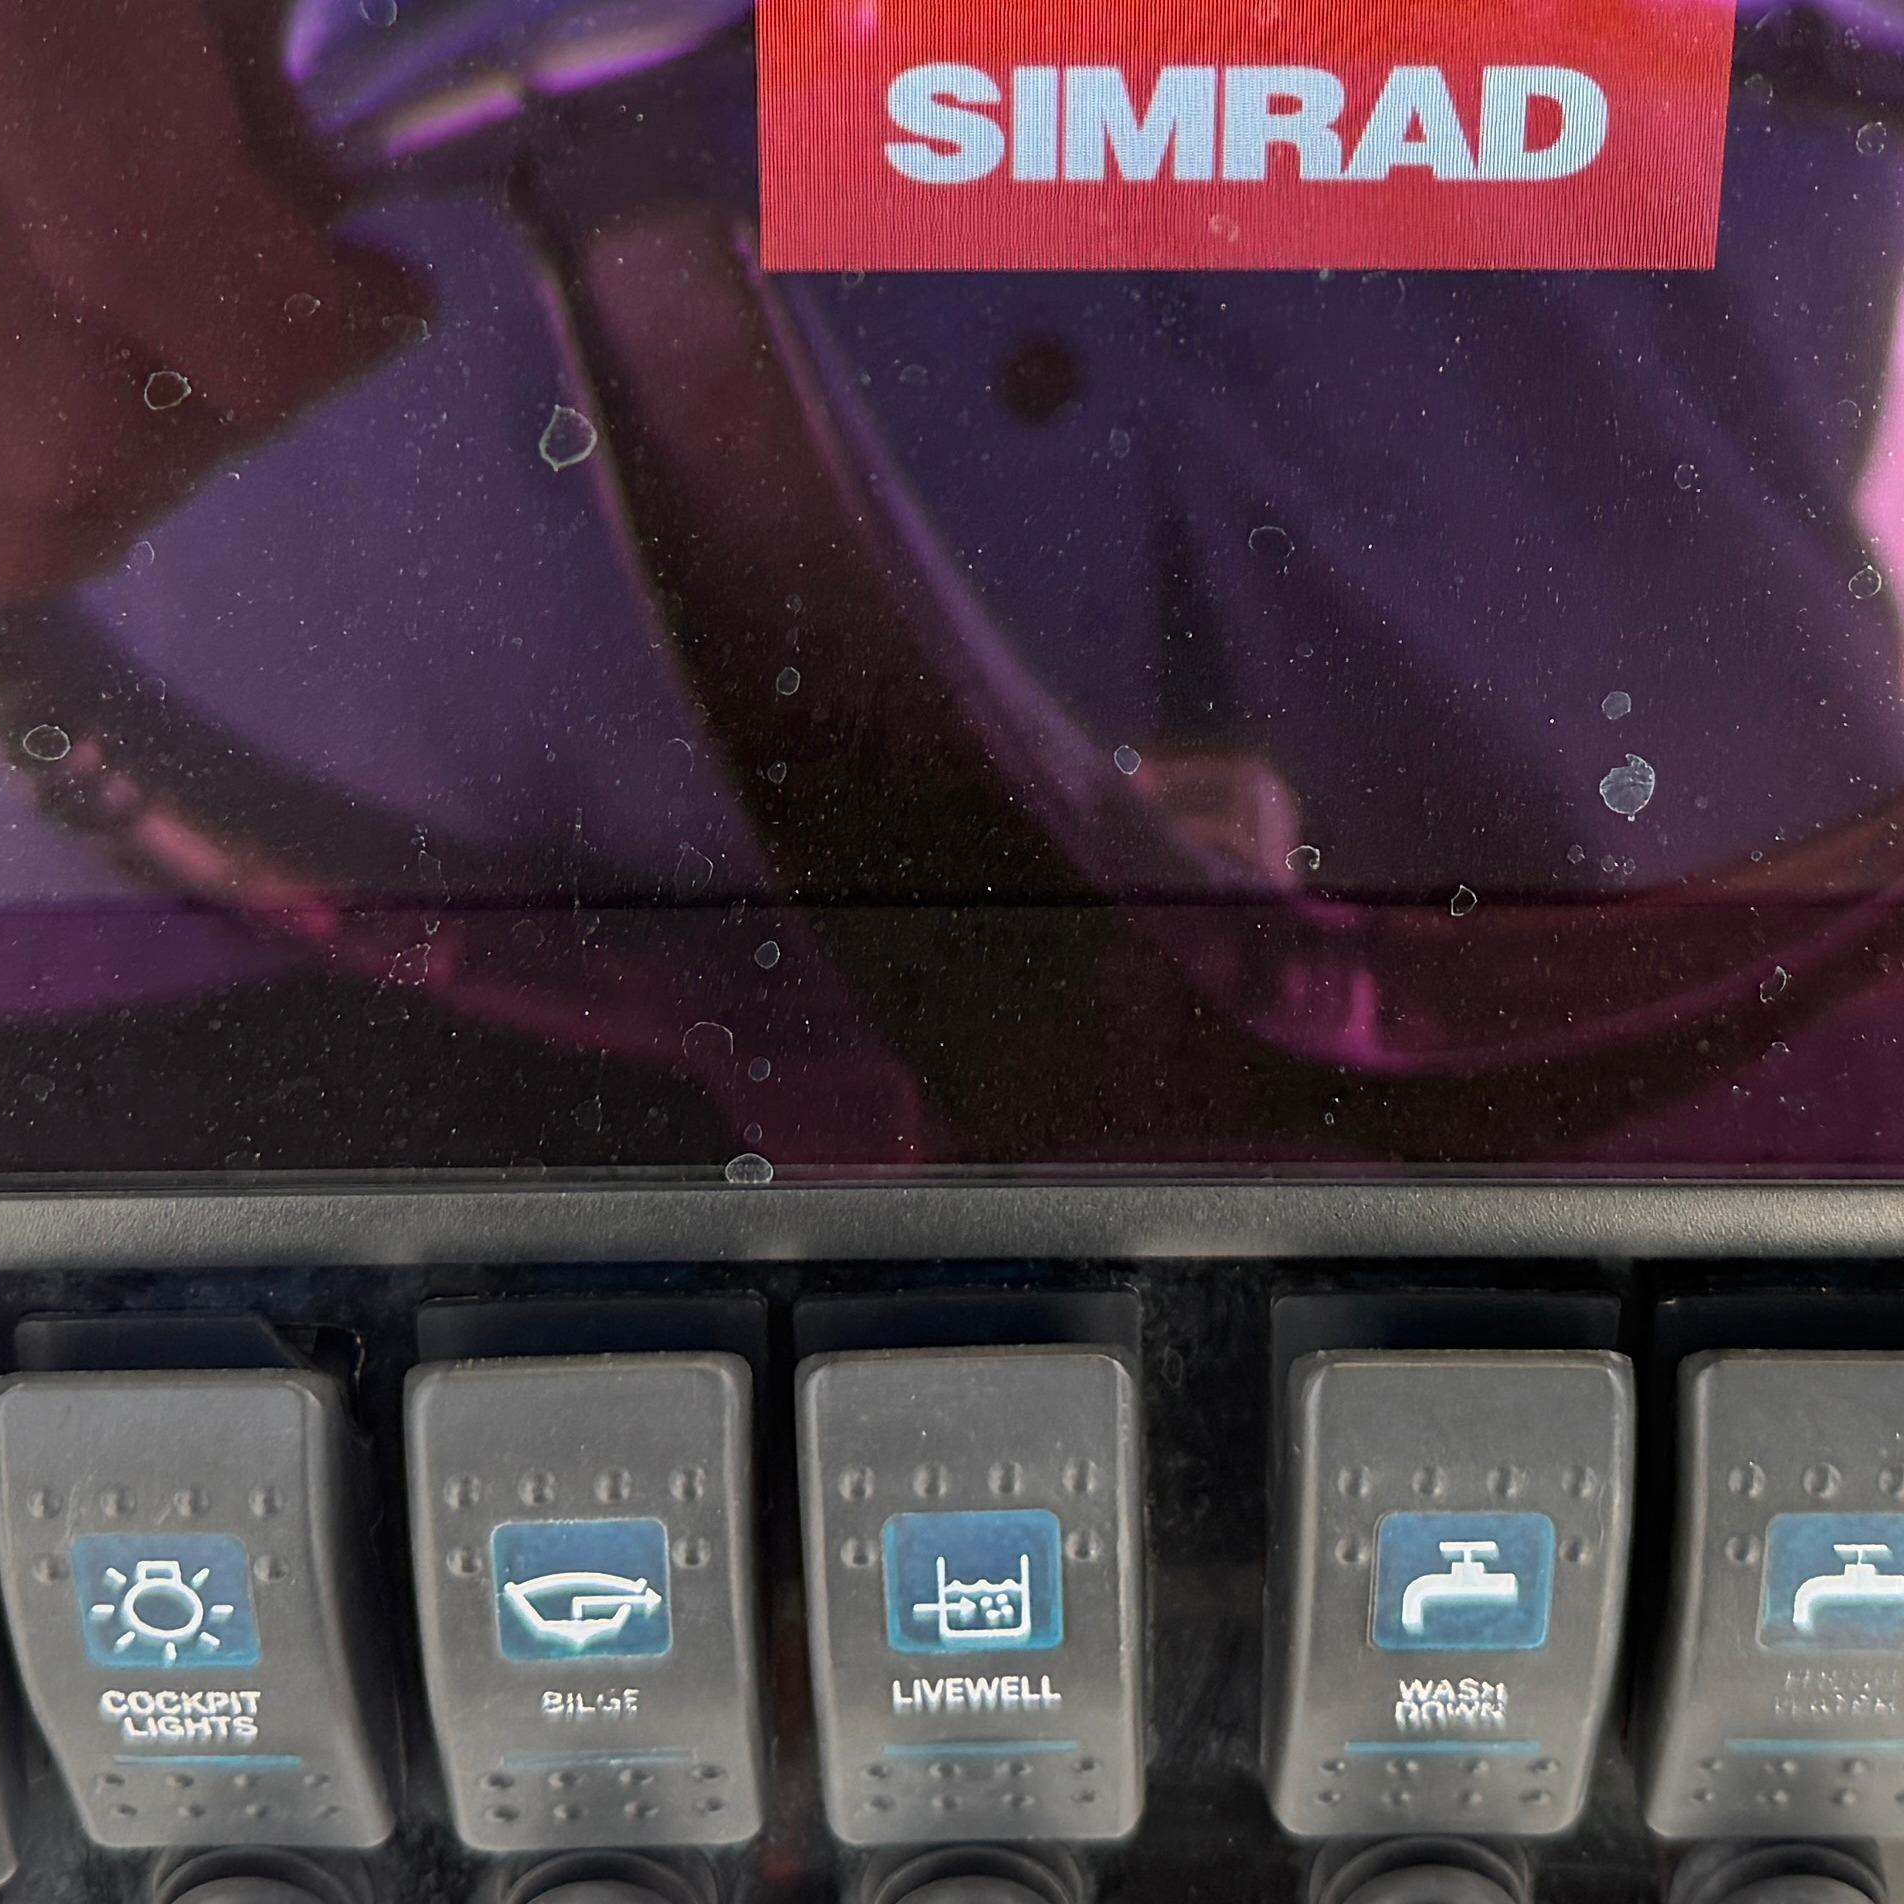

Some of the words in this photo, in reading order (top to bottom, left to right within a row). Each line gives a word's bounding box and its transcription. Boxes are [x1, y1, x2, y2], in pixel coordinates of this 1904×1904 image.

[883, 62, 1608, 185] SIMRAD
[100, 1690, 261, 1717] COCKPIT
[892, 1674, 1062, 1710] LIVEWELL
[1398, 1677, 1508, 1704] WASH
[122, 1715, 259, 1741] LIGHTS
